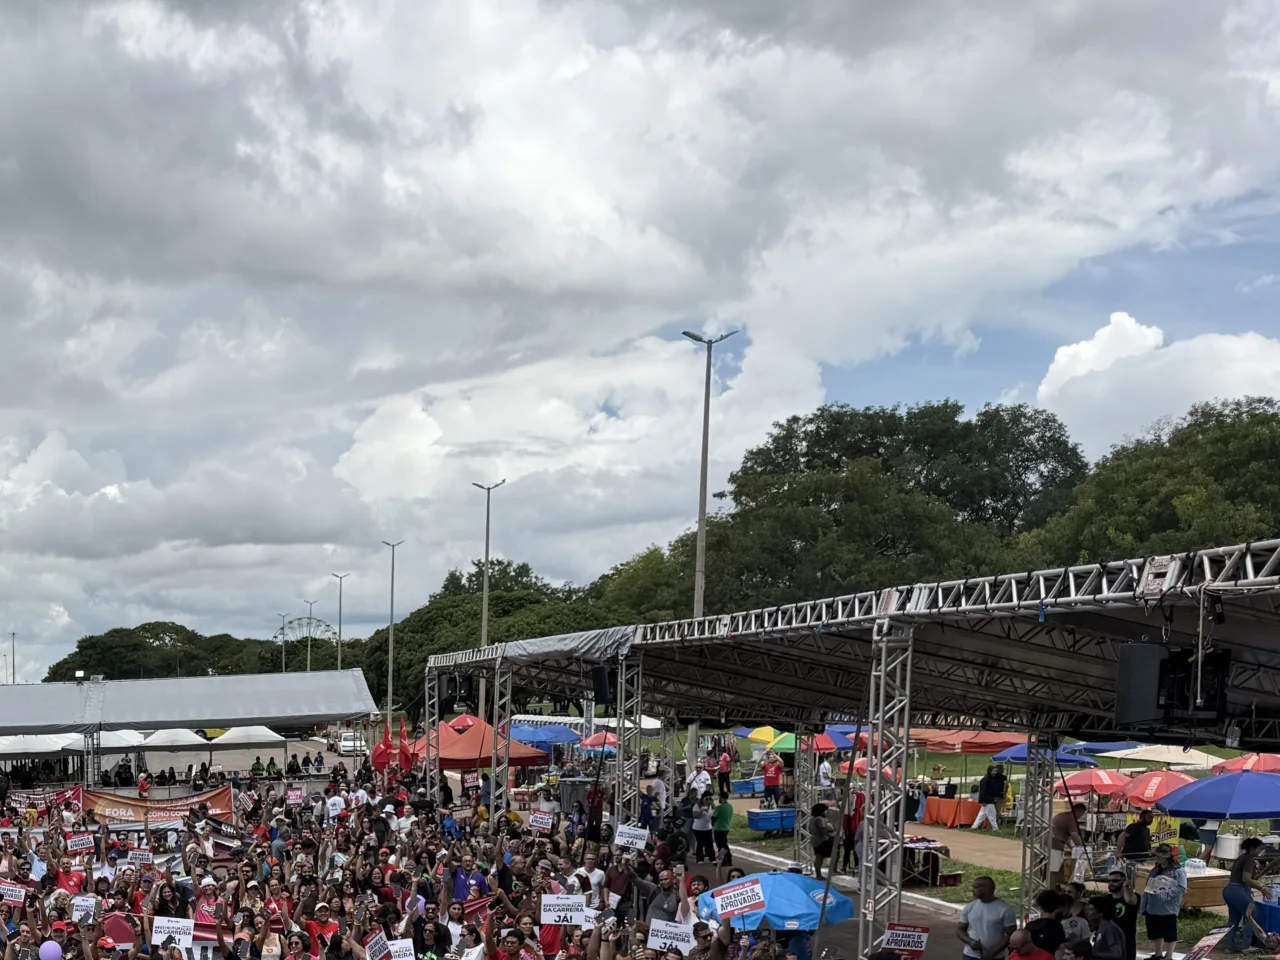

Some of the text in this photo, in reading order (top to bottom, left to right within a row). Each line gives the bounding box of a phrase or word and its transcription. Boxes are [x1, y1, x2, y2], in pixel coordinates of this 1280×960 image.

[105, 808, 134, 816] FORA
[1150, 829, 1177, 842] Churros
[720, 892, 761, 911] APROVADOS
[554, 913, 572, 923] JÁ!
[886, 937, 924, 948] APROVADOS
